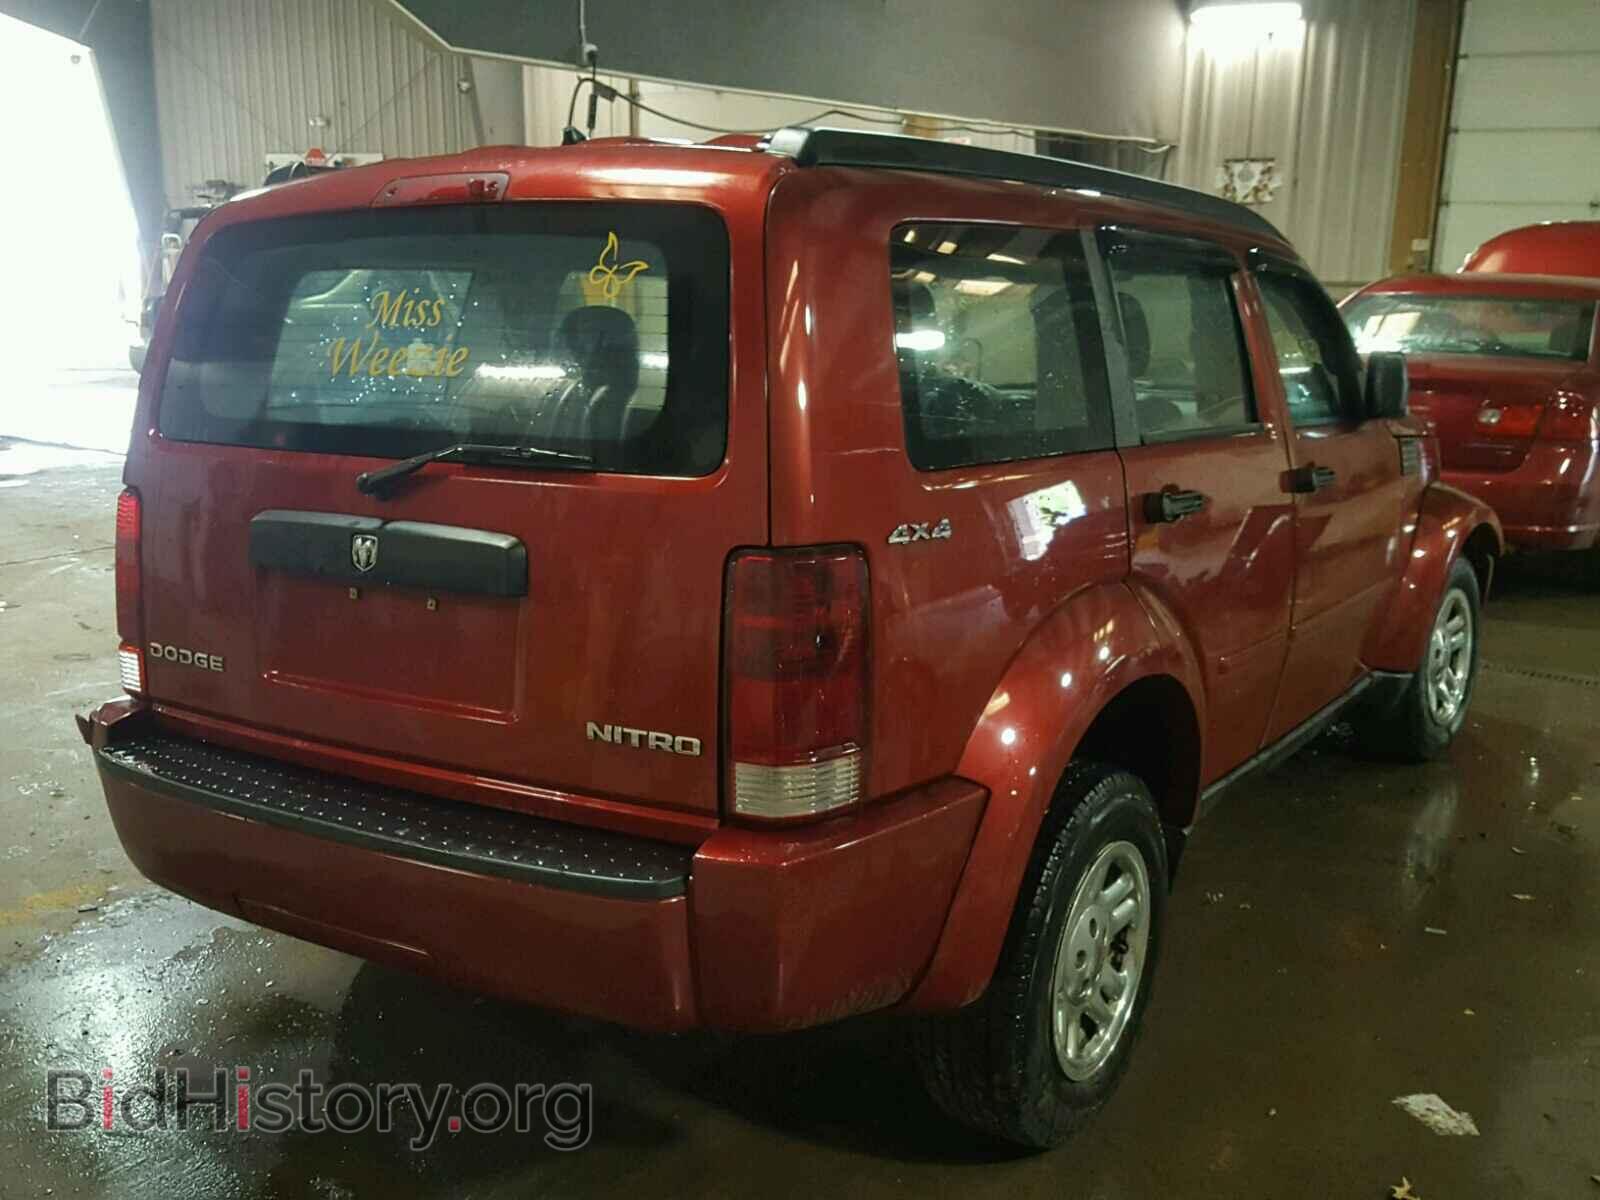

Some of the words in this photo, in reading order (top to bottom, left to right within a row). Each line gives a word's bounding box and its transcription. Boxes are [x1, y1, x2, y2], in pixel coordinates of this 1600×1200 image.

[366, 287, 446, 329] Miss
[149, 641, 225, 673] DODGE
[586, 721, 702, 756] NITRO
